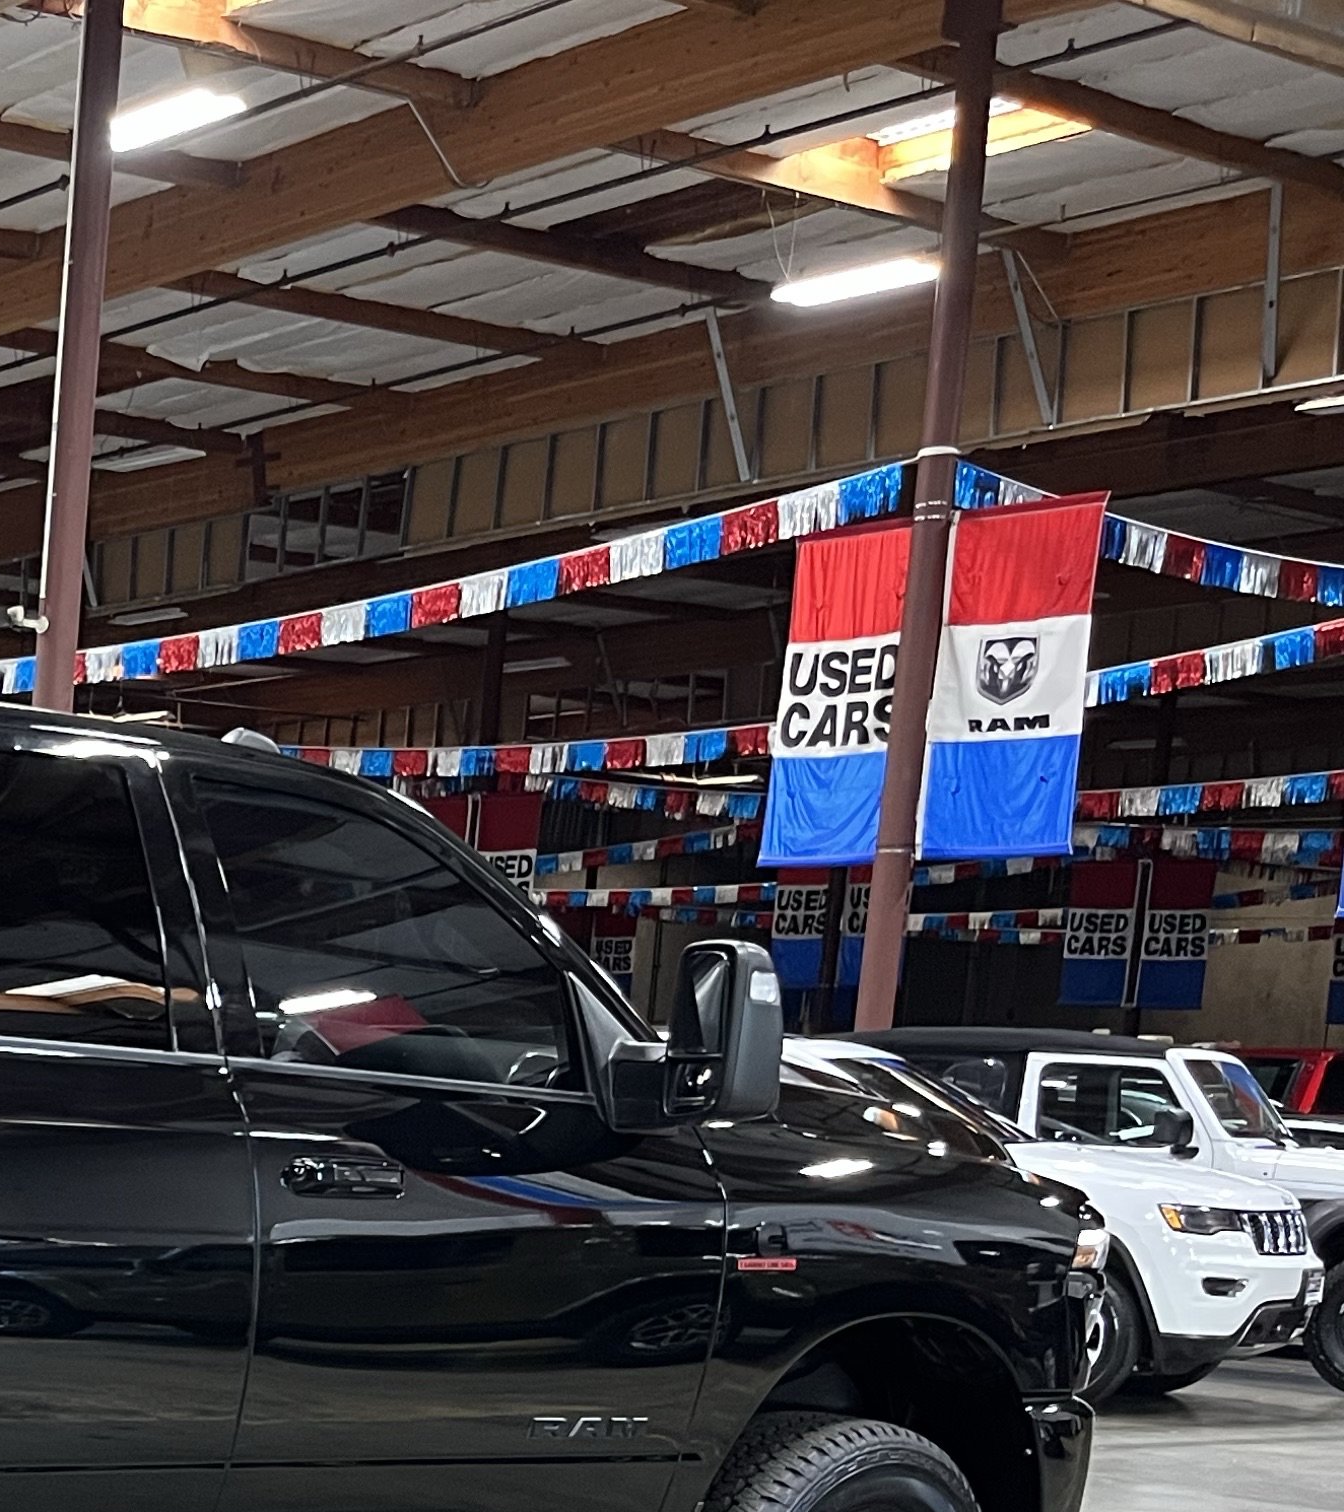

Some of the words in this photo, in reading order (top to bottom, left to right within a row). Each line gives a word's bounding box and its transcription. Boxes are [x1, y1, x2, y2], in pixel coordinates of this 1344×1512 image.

[789, 644, 900, 697] USED
[781, 696, 894, 748] CARS
[968, 714, 1050, 732] RAM
[1070, 912, 1128, 933] USED
[1149, 913, 1206, 934] USED
[1067, 935, 1127, 956] CARS
[1144, 936, 1206, 957] CARS
[526, 1417, 649, 1439] RAM
